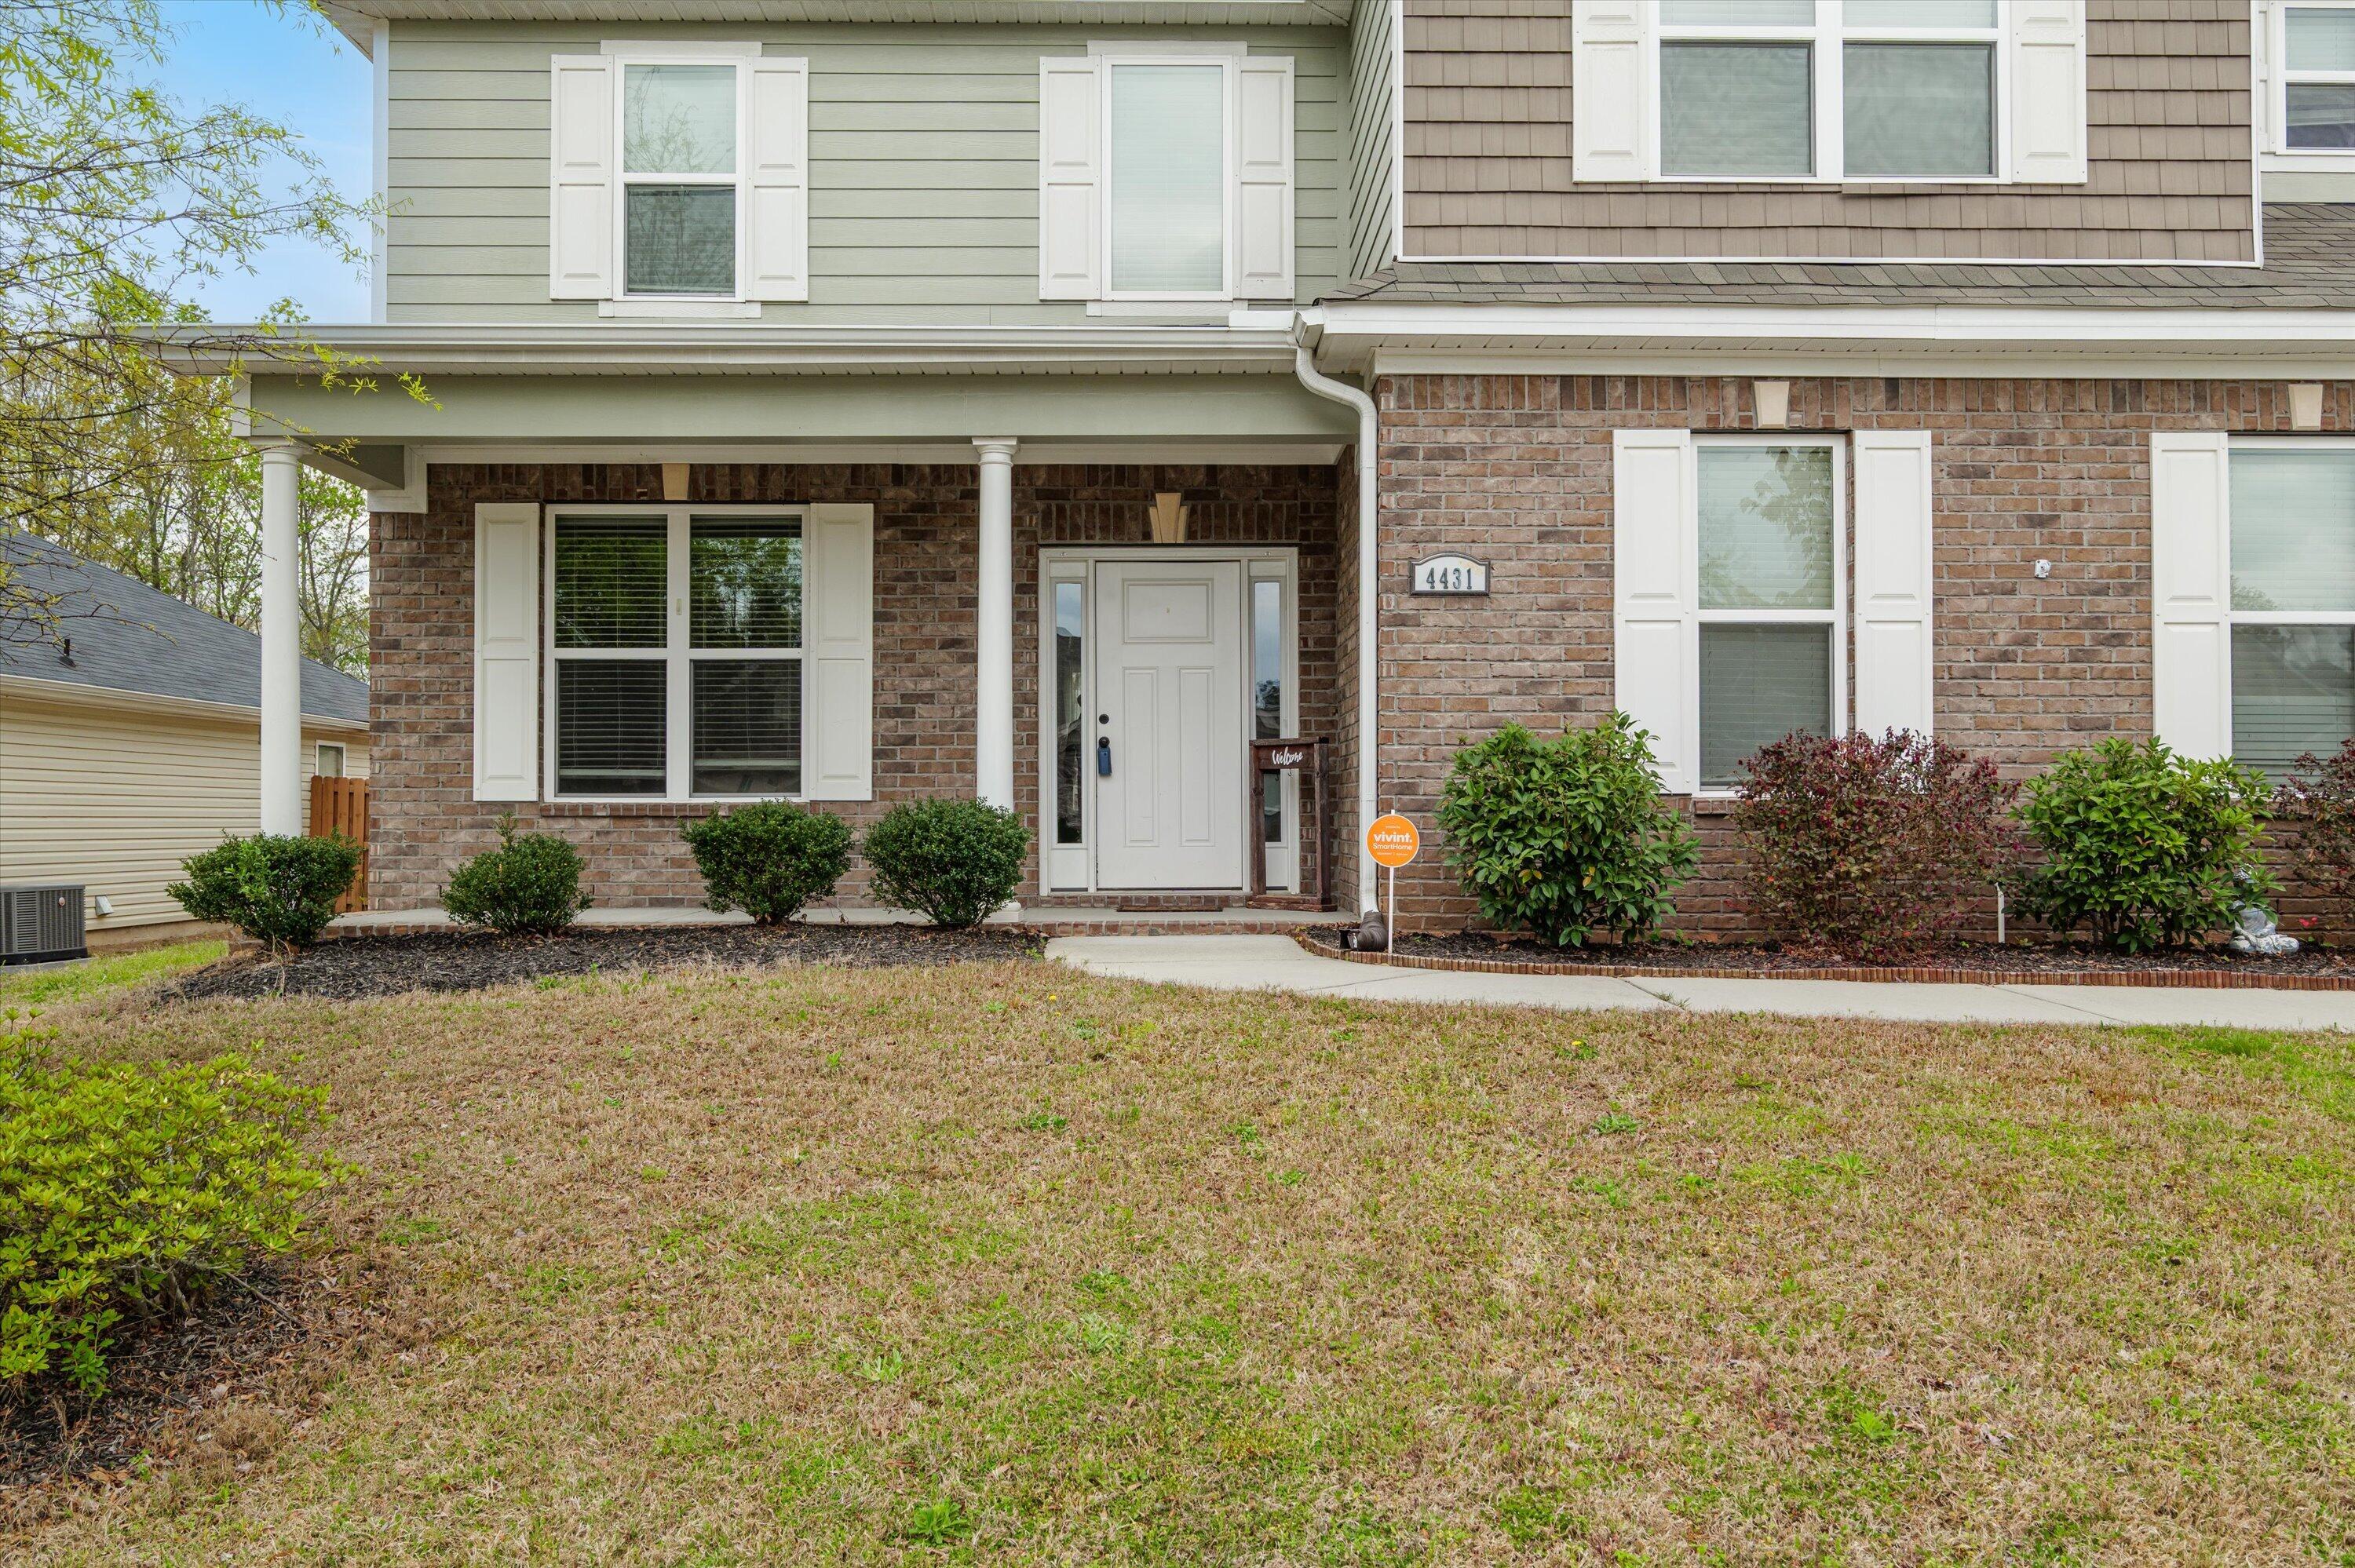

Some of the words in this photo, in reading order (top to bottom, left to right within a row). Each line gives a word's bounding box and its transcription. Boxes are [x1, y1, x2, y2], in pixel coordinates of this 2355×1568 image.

[1426, 567, 1472, 589] 4431
[1272, 746, 1303, 765] Welcome
[1373, 831, 1412, 843] vivint.
